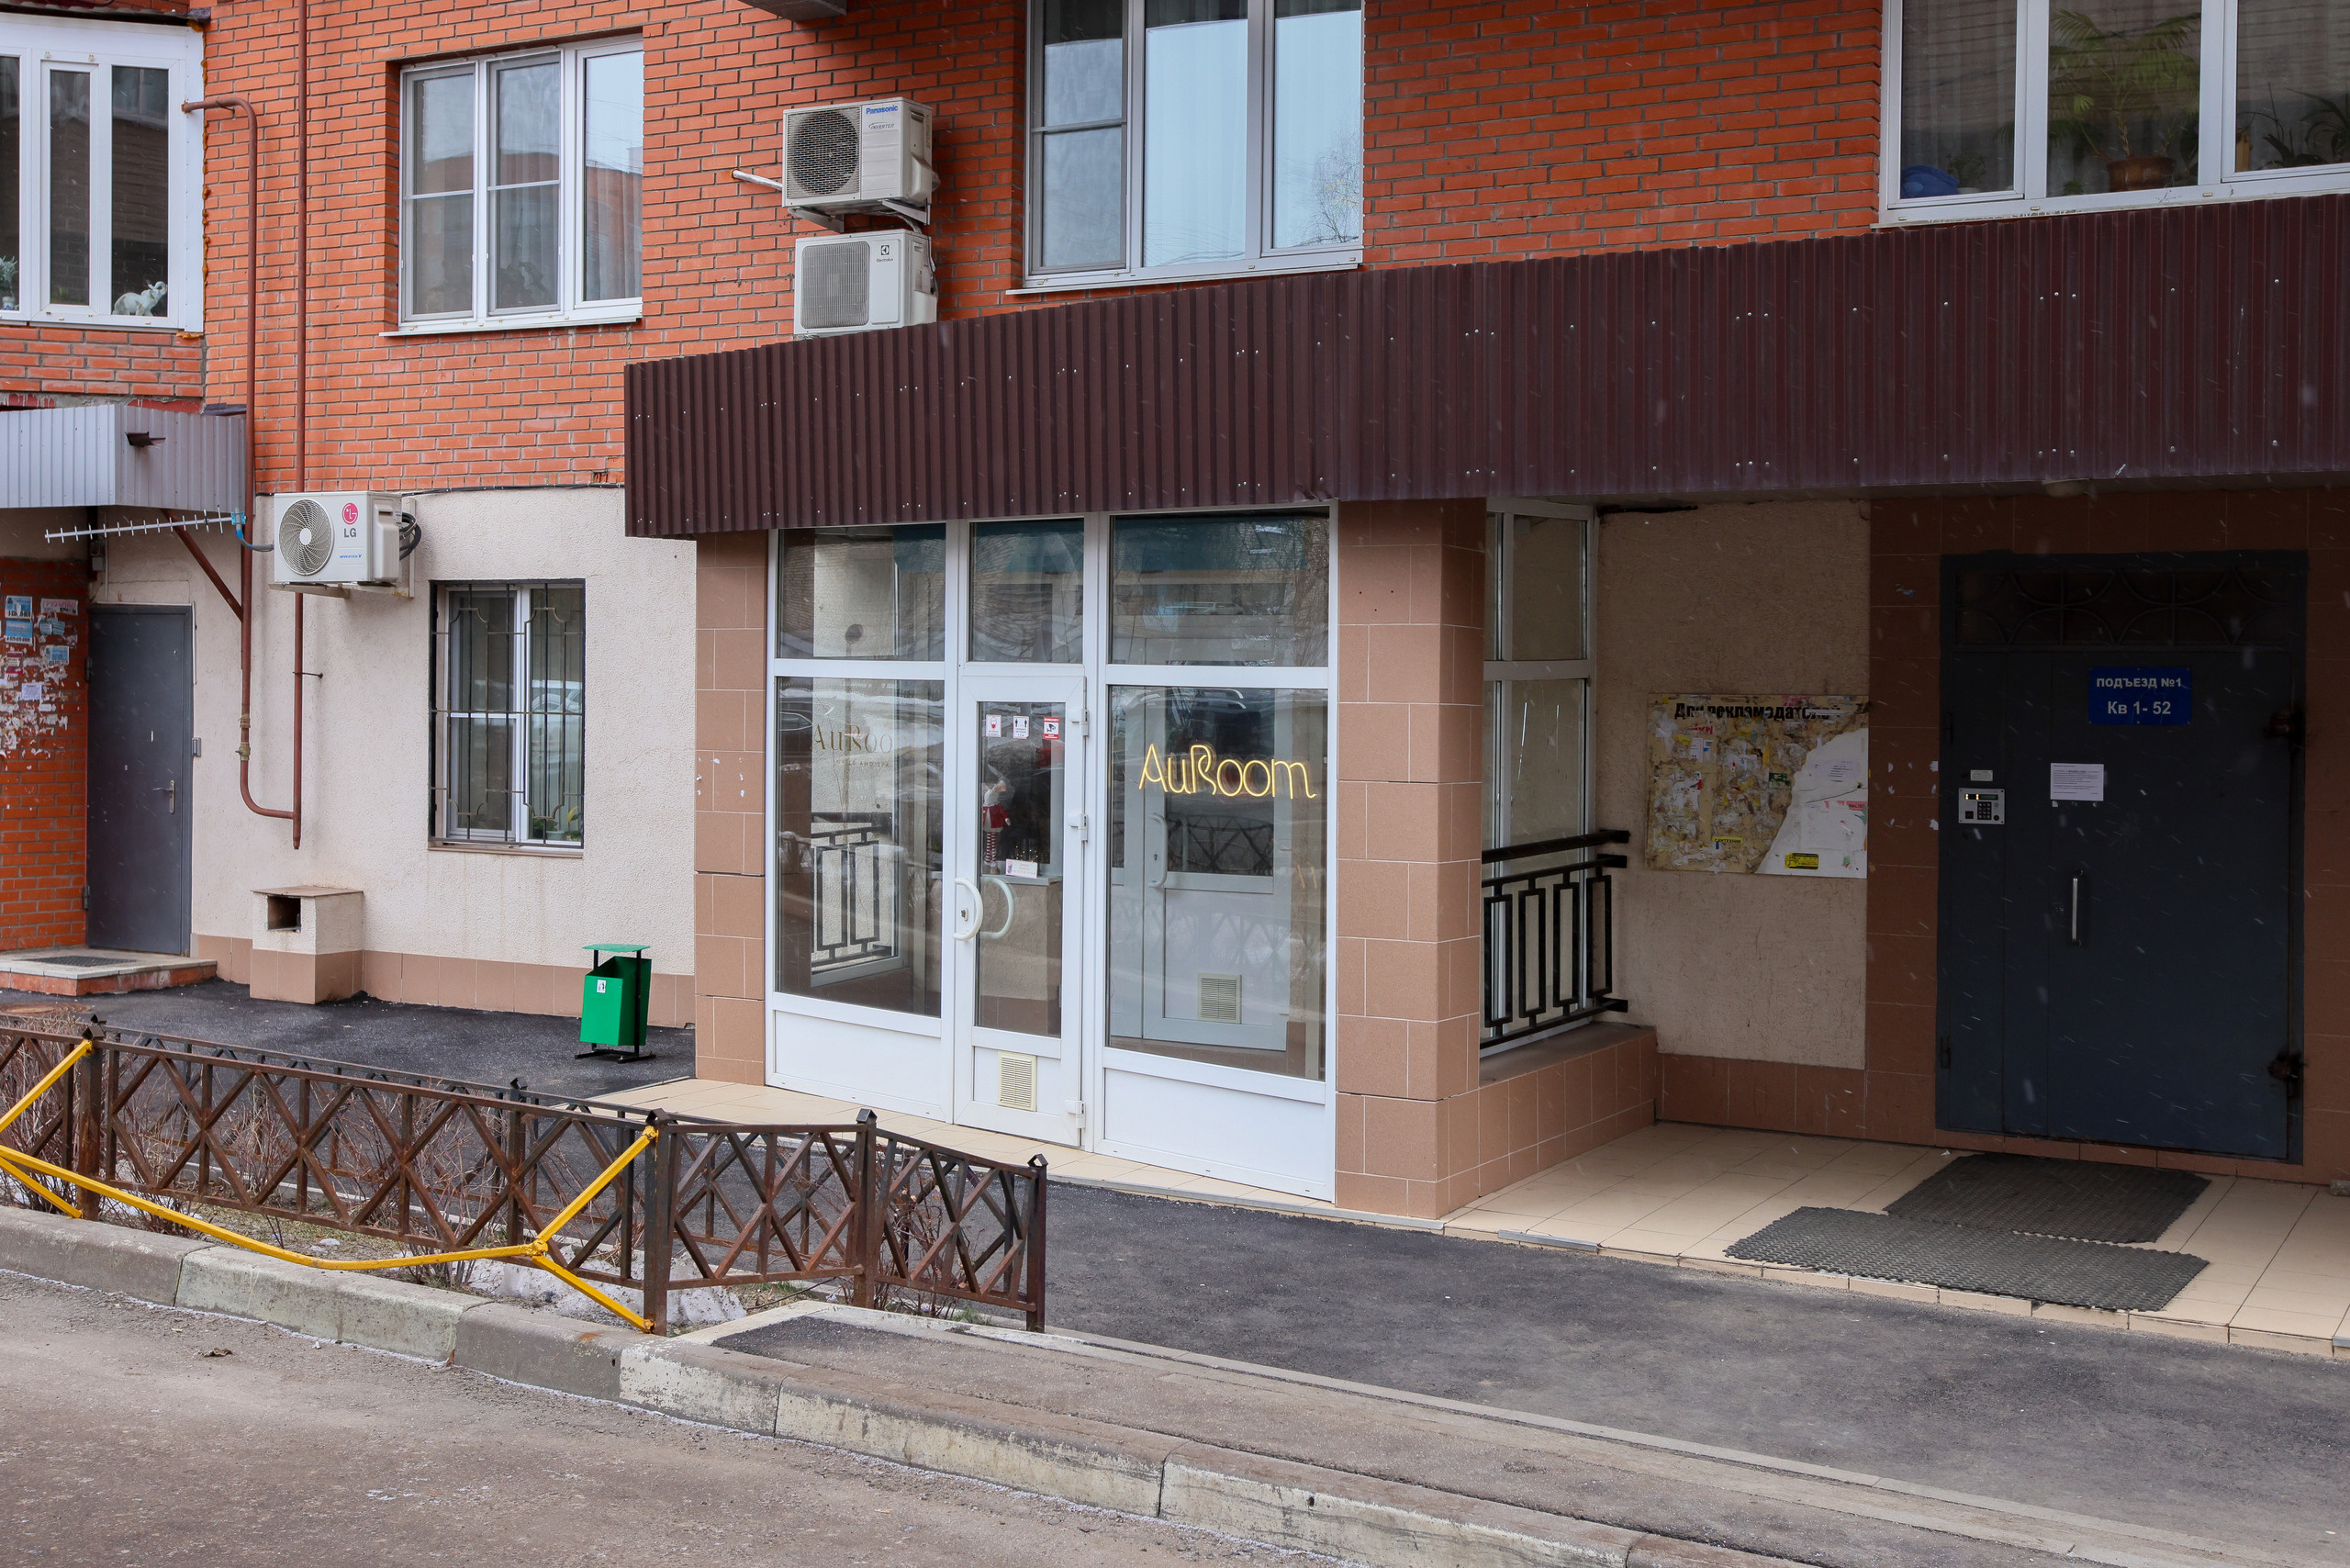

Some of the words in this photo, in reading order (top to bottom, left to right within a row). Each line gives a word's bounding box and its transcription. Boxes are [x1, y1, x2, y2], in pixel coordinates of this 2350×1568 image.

[866, 105, 899, 115] Panasonic
[343, 528, 356, 538] LG
[2096, 678, 2157, 689] ПОДЪЕЗД
[2160, 677, 2182, 688] №1
[2107, 701, 2128, 715] Кв
[1138, 744, 1318, 800] AuRoom
